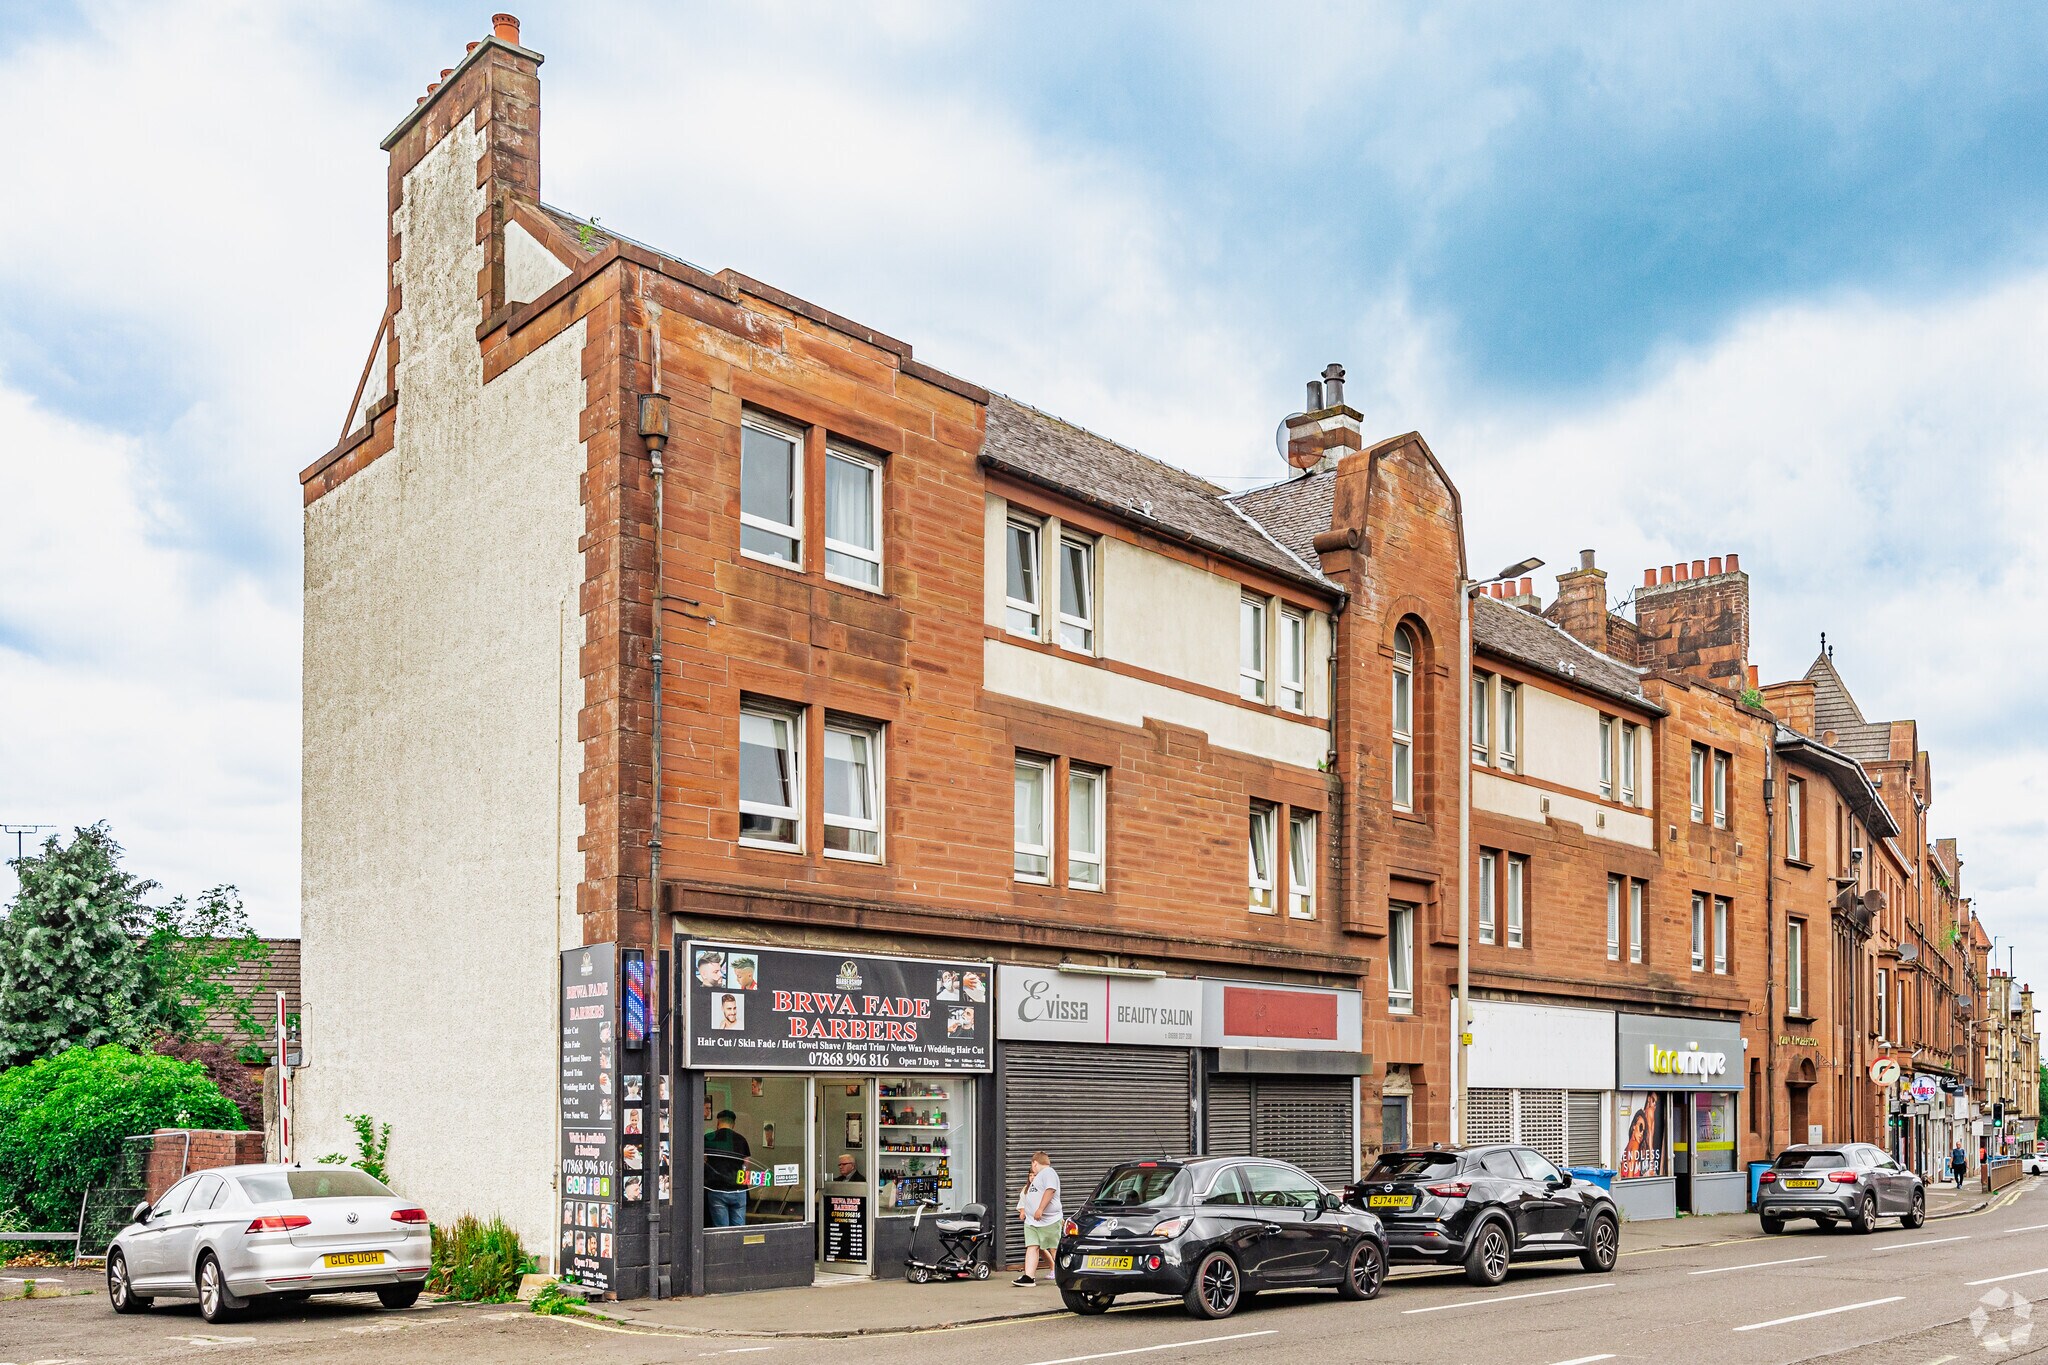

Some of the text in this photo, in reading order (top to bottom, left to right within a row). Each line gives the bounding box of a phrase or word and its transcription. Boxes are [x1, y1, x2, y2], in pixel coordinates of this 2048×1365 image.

[566, 982, 608, 1000] BRWA FADE
[772, 990, 931, 1018] BRWA FADE
[1018, 980, 1088, 1022] Evissa
[570, 1004, 604, 1020] BARBERS
[1118, 1006, 1192, 1026] BEAUTY SALON
[788, 1016, 918, 1042] BARBERS
[697, 1037, 716, 1046] Hair
[717, 1038, 732, 1047] Cut
[738, 1038, 756, 1048] Skin
[758, 1039, 776, 1048] Fade
[782, 1040, 797, 1049] Hot
[798, 1041, 818, 1050] Towel
[820, 1041, 841, 1050] Shave
[847, 1042, 867, 1051] Beard
[869, 1043, 885, 1052] Trim
[891, 1044, 906, 1052] Nose
[908, 1044, 922, 1052] Wax
[927, 1045, 955, 1055] Wedding
[808, 1052, 844, 1066] 07868
[846, 1052, 866, 1066] 996
[870, 1054, 889, 1066] 816
[898, 1057, 916, 1066] Open
[923, 1058, 939, 1067] Days
[1623, 1149, 1660, 1161] ENDLESS
[562, 1159, 614, 1176] 07868 996 816
[1624, 1161, 1659, 1172] SUMMER
[736, 1169, 772, 1187] BARBER
[906, 1182, 930, 1190] OPEN
[331, 1254, 378, 1264] GL16 UOH
[1113, 1258, 1129, 1267] RYS
